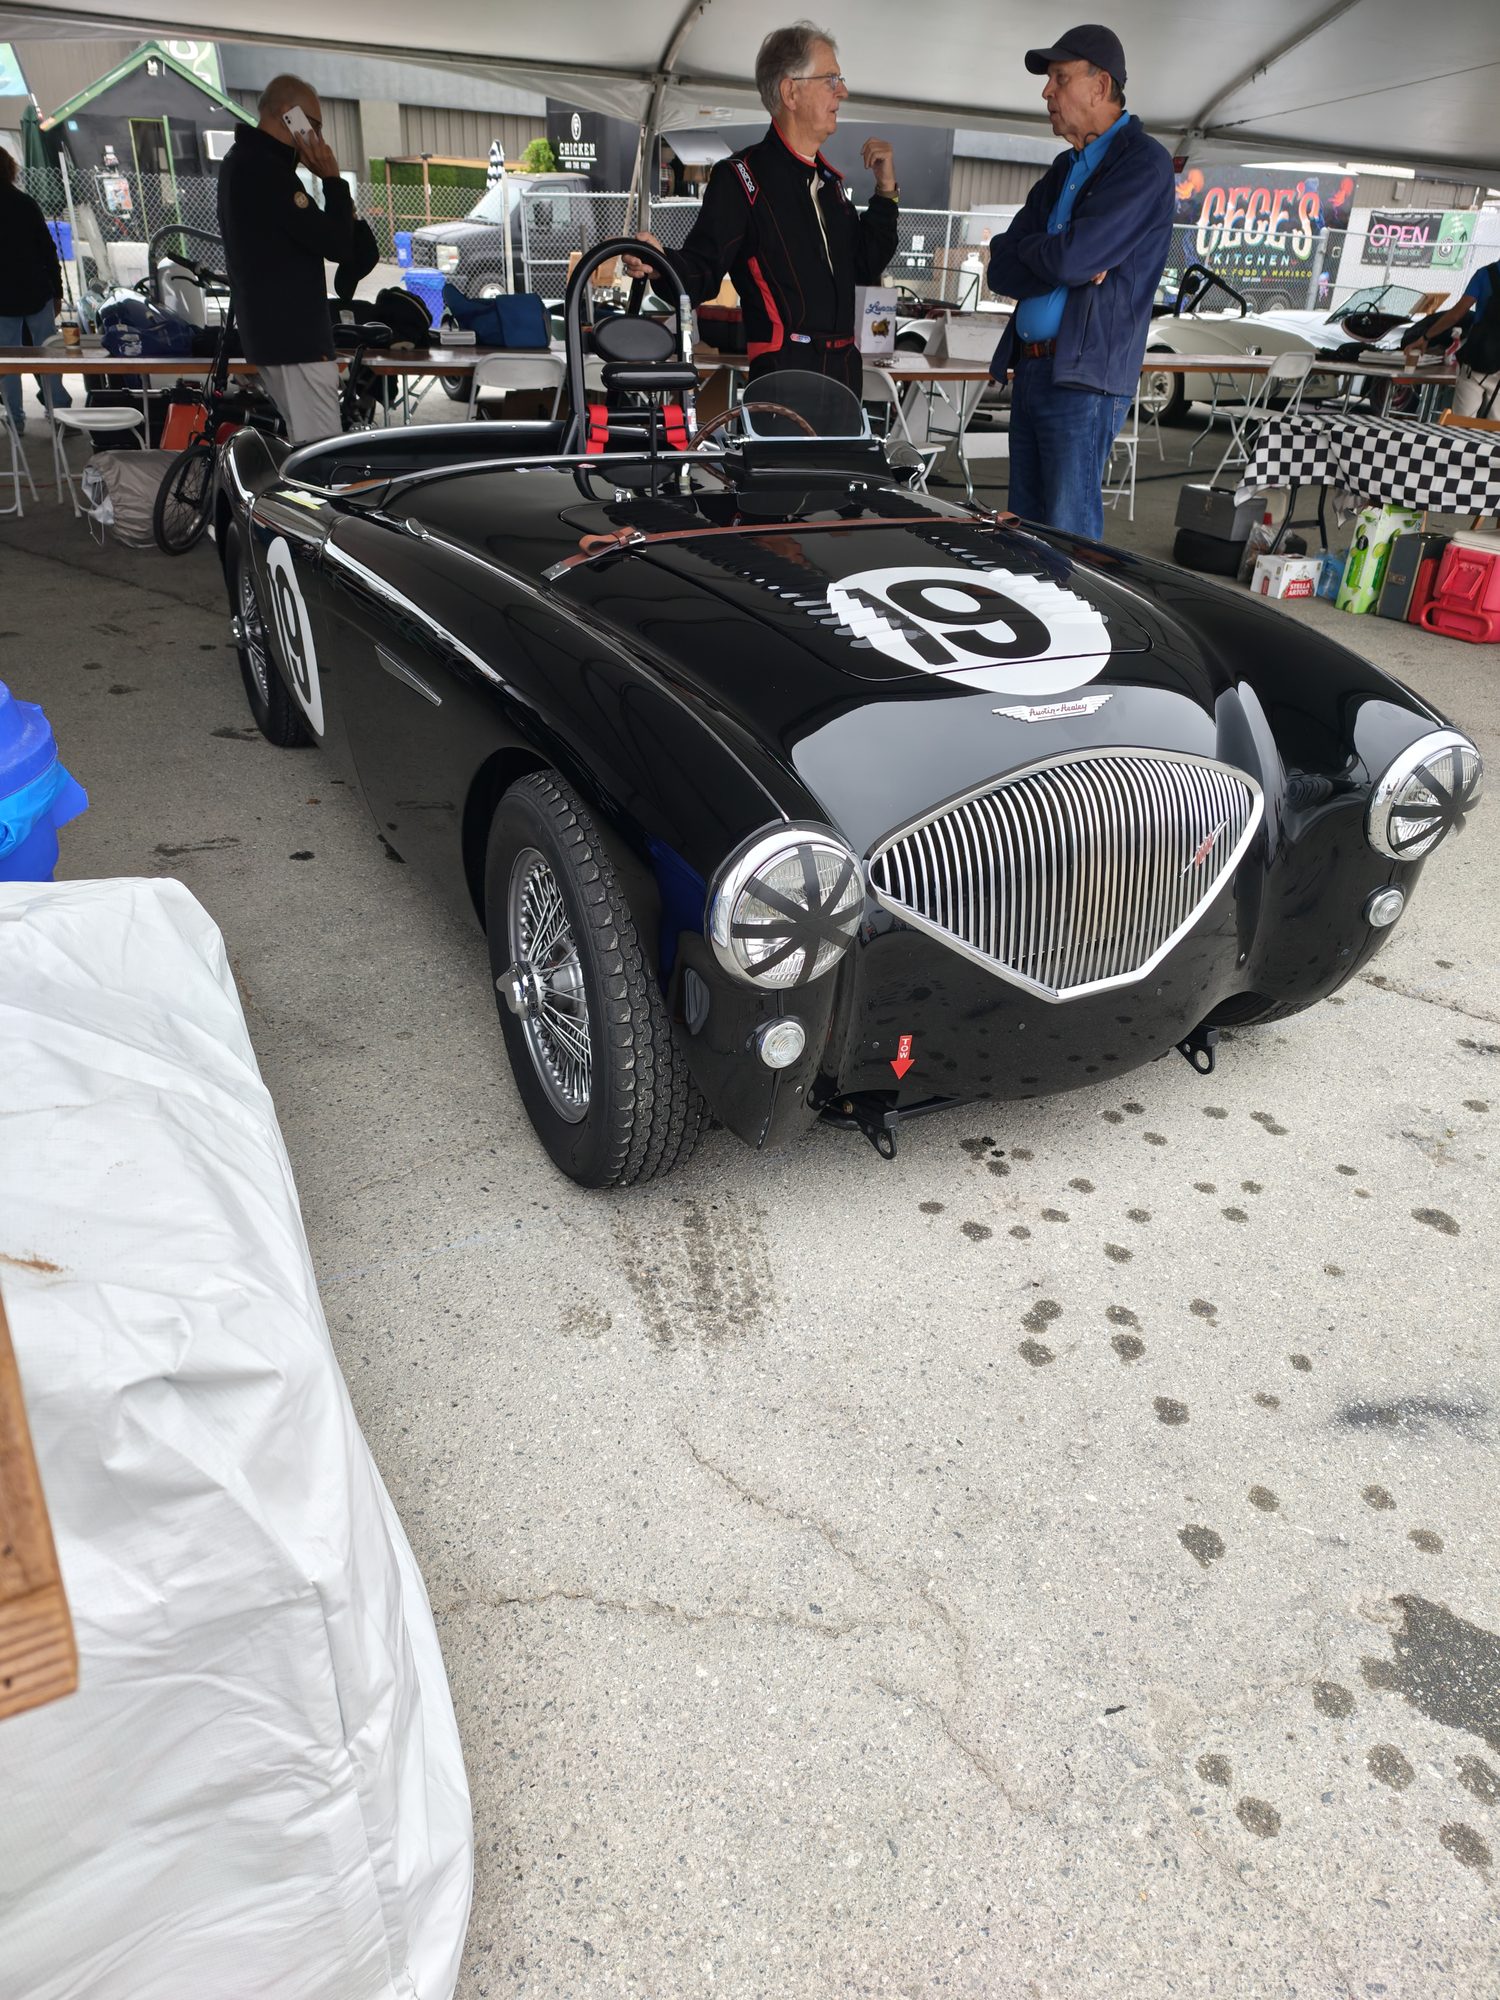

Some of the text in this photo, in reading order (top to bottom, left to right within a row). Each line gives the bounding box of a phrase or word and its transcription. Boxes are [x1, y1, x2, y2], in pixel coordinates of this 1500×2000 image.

[559, 142, 596, 156] CHICKEN
[1369, 223, 1430, 249] OPEN
[1213, 253, 1290, 266] KITCHEN
[1232, 269, 1258, 277] FOOD
[1272, 270, 1314, 278] MARISCO
[835, 579, 1052, 666] 19
[1029, 703, 1088, 717] Austin-Healey
[900, 1038, 910, 1059] TOW
